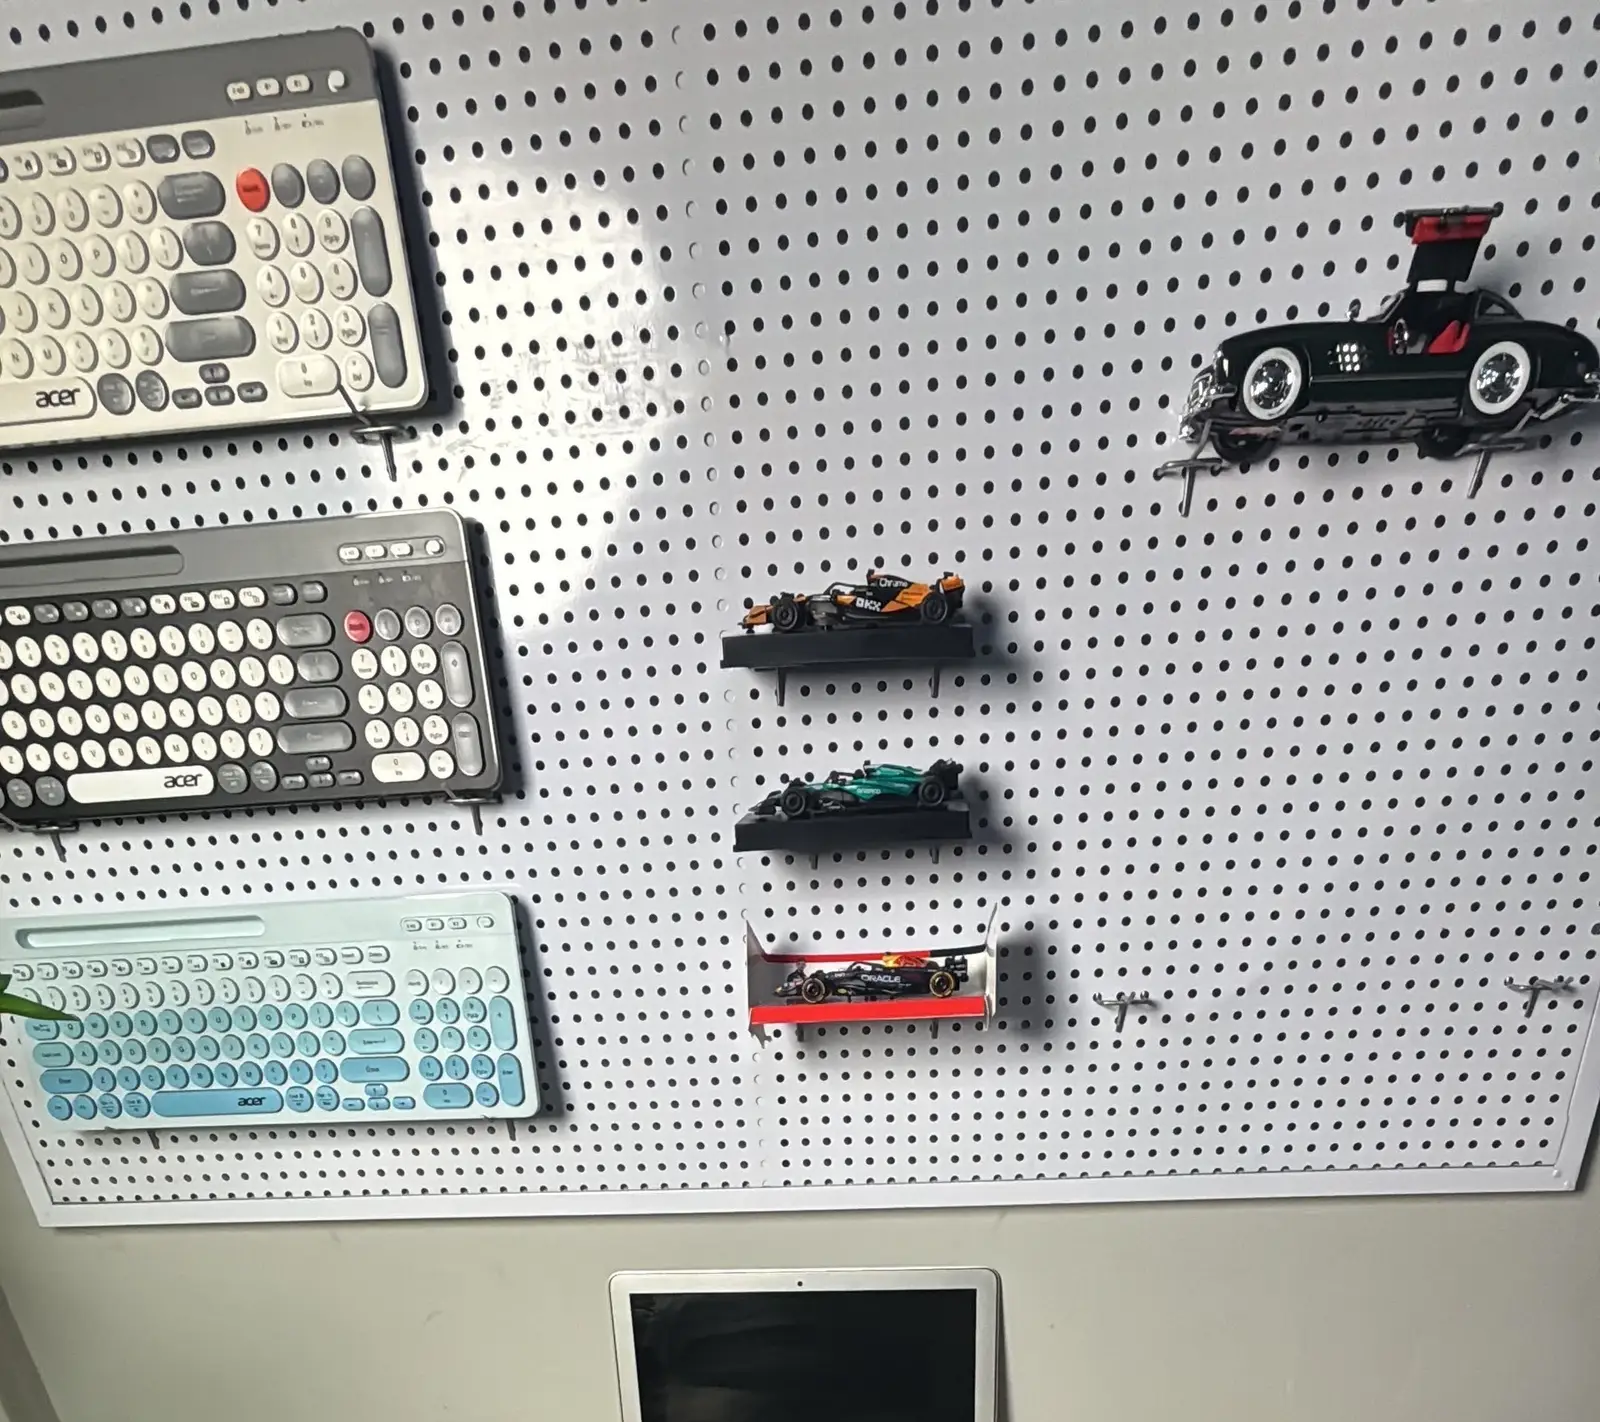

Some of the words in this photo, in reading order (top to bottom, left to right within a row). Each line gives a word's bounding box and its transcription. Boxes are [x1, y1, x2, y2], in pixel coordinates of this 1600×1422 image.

[36, 388, 80, 408] acer
[856, 598, 881, 612] OKX
[164, 774, 203, 788] acer
[860, 973, 902, 984] ORACLE
[237, 1096, 267, 1107] acer
